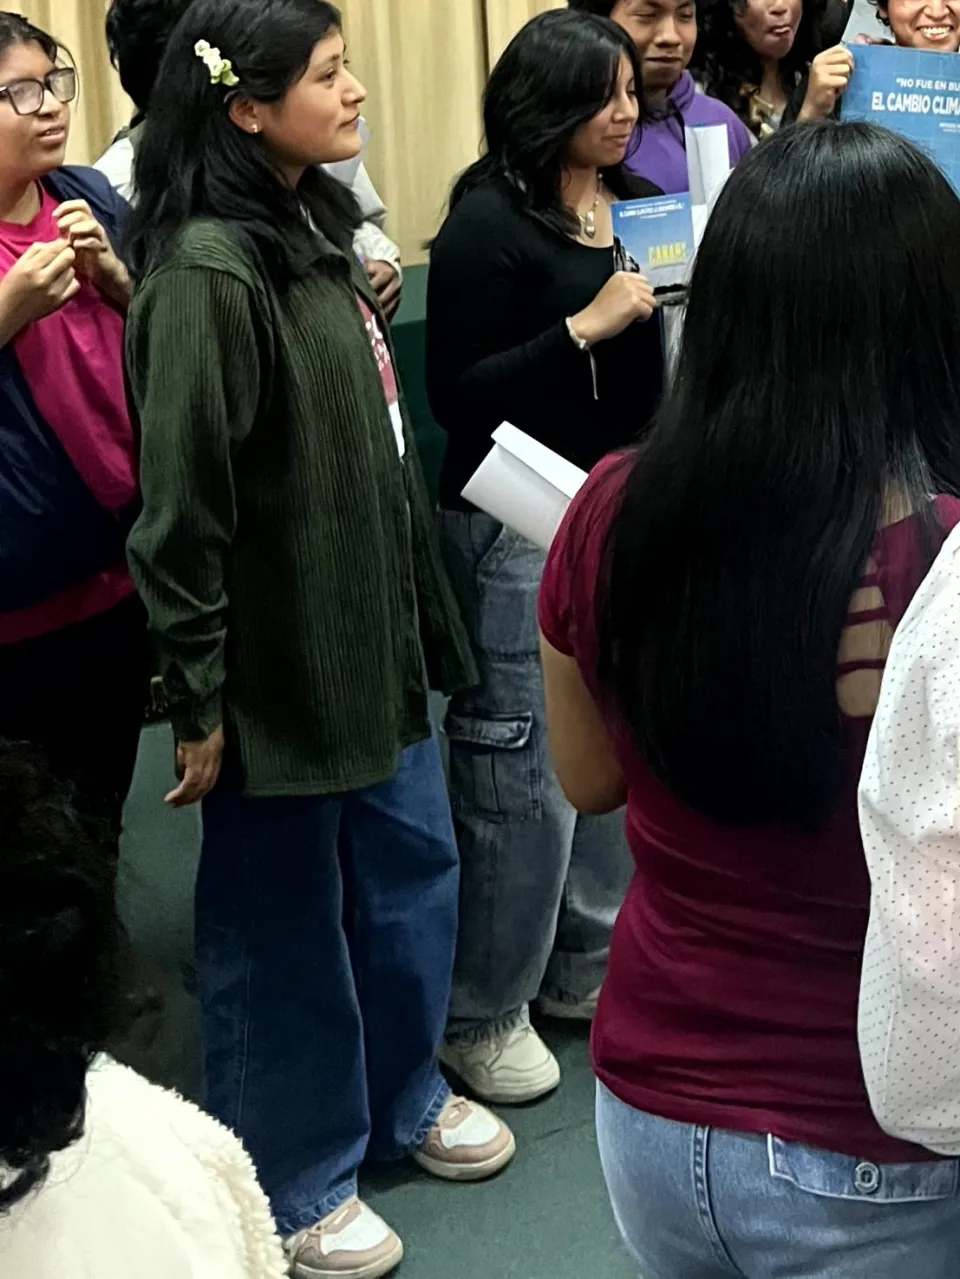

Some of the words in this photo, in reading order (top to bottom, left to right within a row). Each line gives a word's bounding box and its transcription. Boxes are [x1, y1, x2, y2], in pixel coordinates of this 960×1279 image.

[915, 79, 933, 89] FUE
[934, 81, 947, 90] EN
[871, 91, 886, 111] EL
[886, 92, 931, 114] CAMBIO
